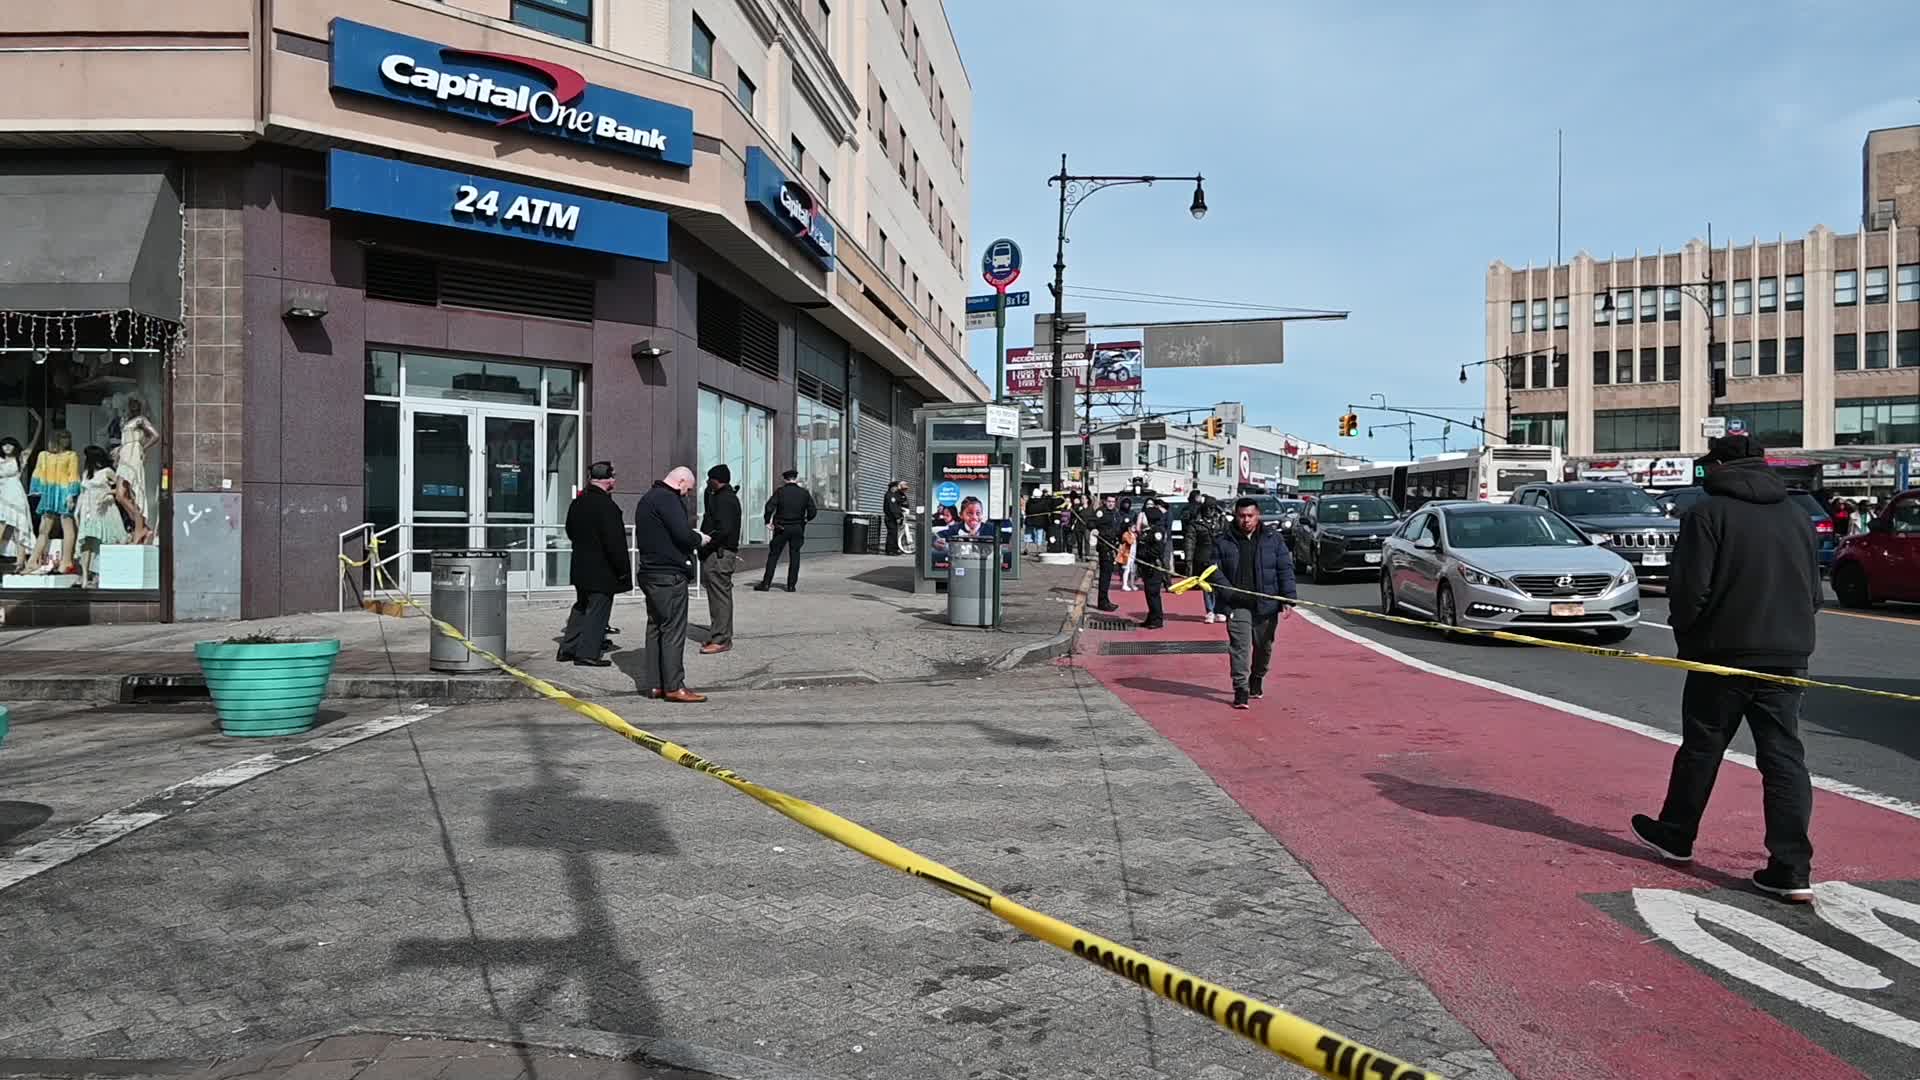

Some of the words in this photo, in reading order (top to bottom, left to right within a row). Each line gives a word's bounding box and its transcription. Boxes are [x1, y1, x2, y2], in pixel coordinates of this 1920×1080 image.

[595, 115, 668, 151] Bank
[454, 185, 500, 216] 24
[503, 195, 580, 231] ATM
[1065, 352, 1085, 360] AUTO
